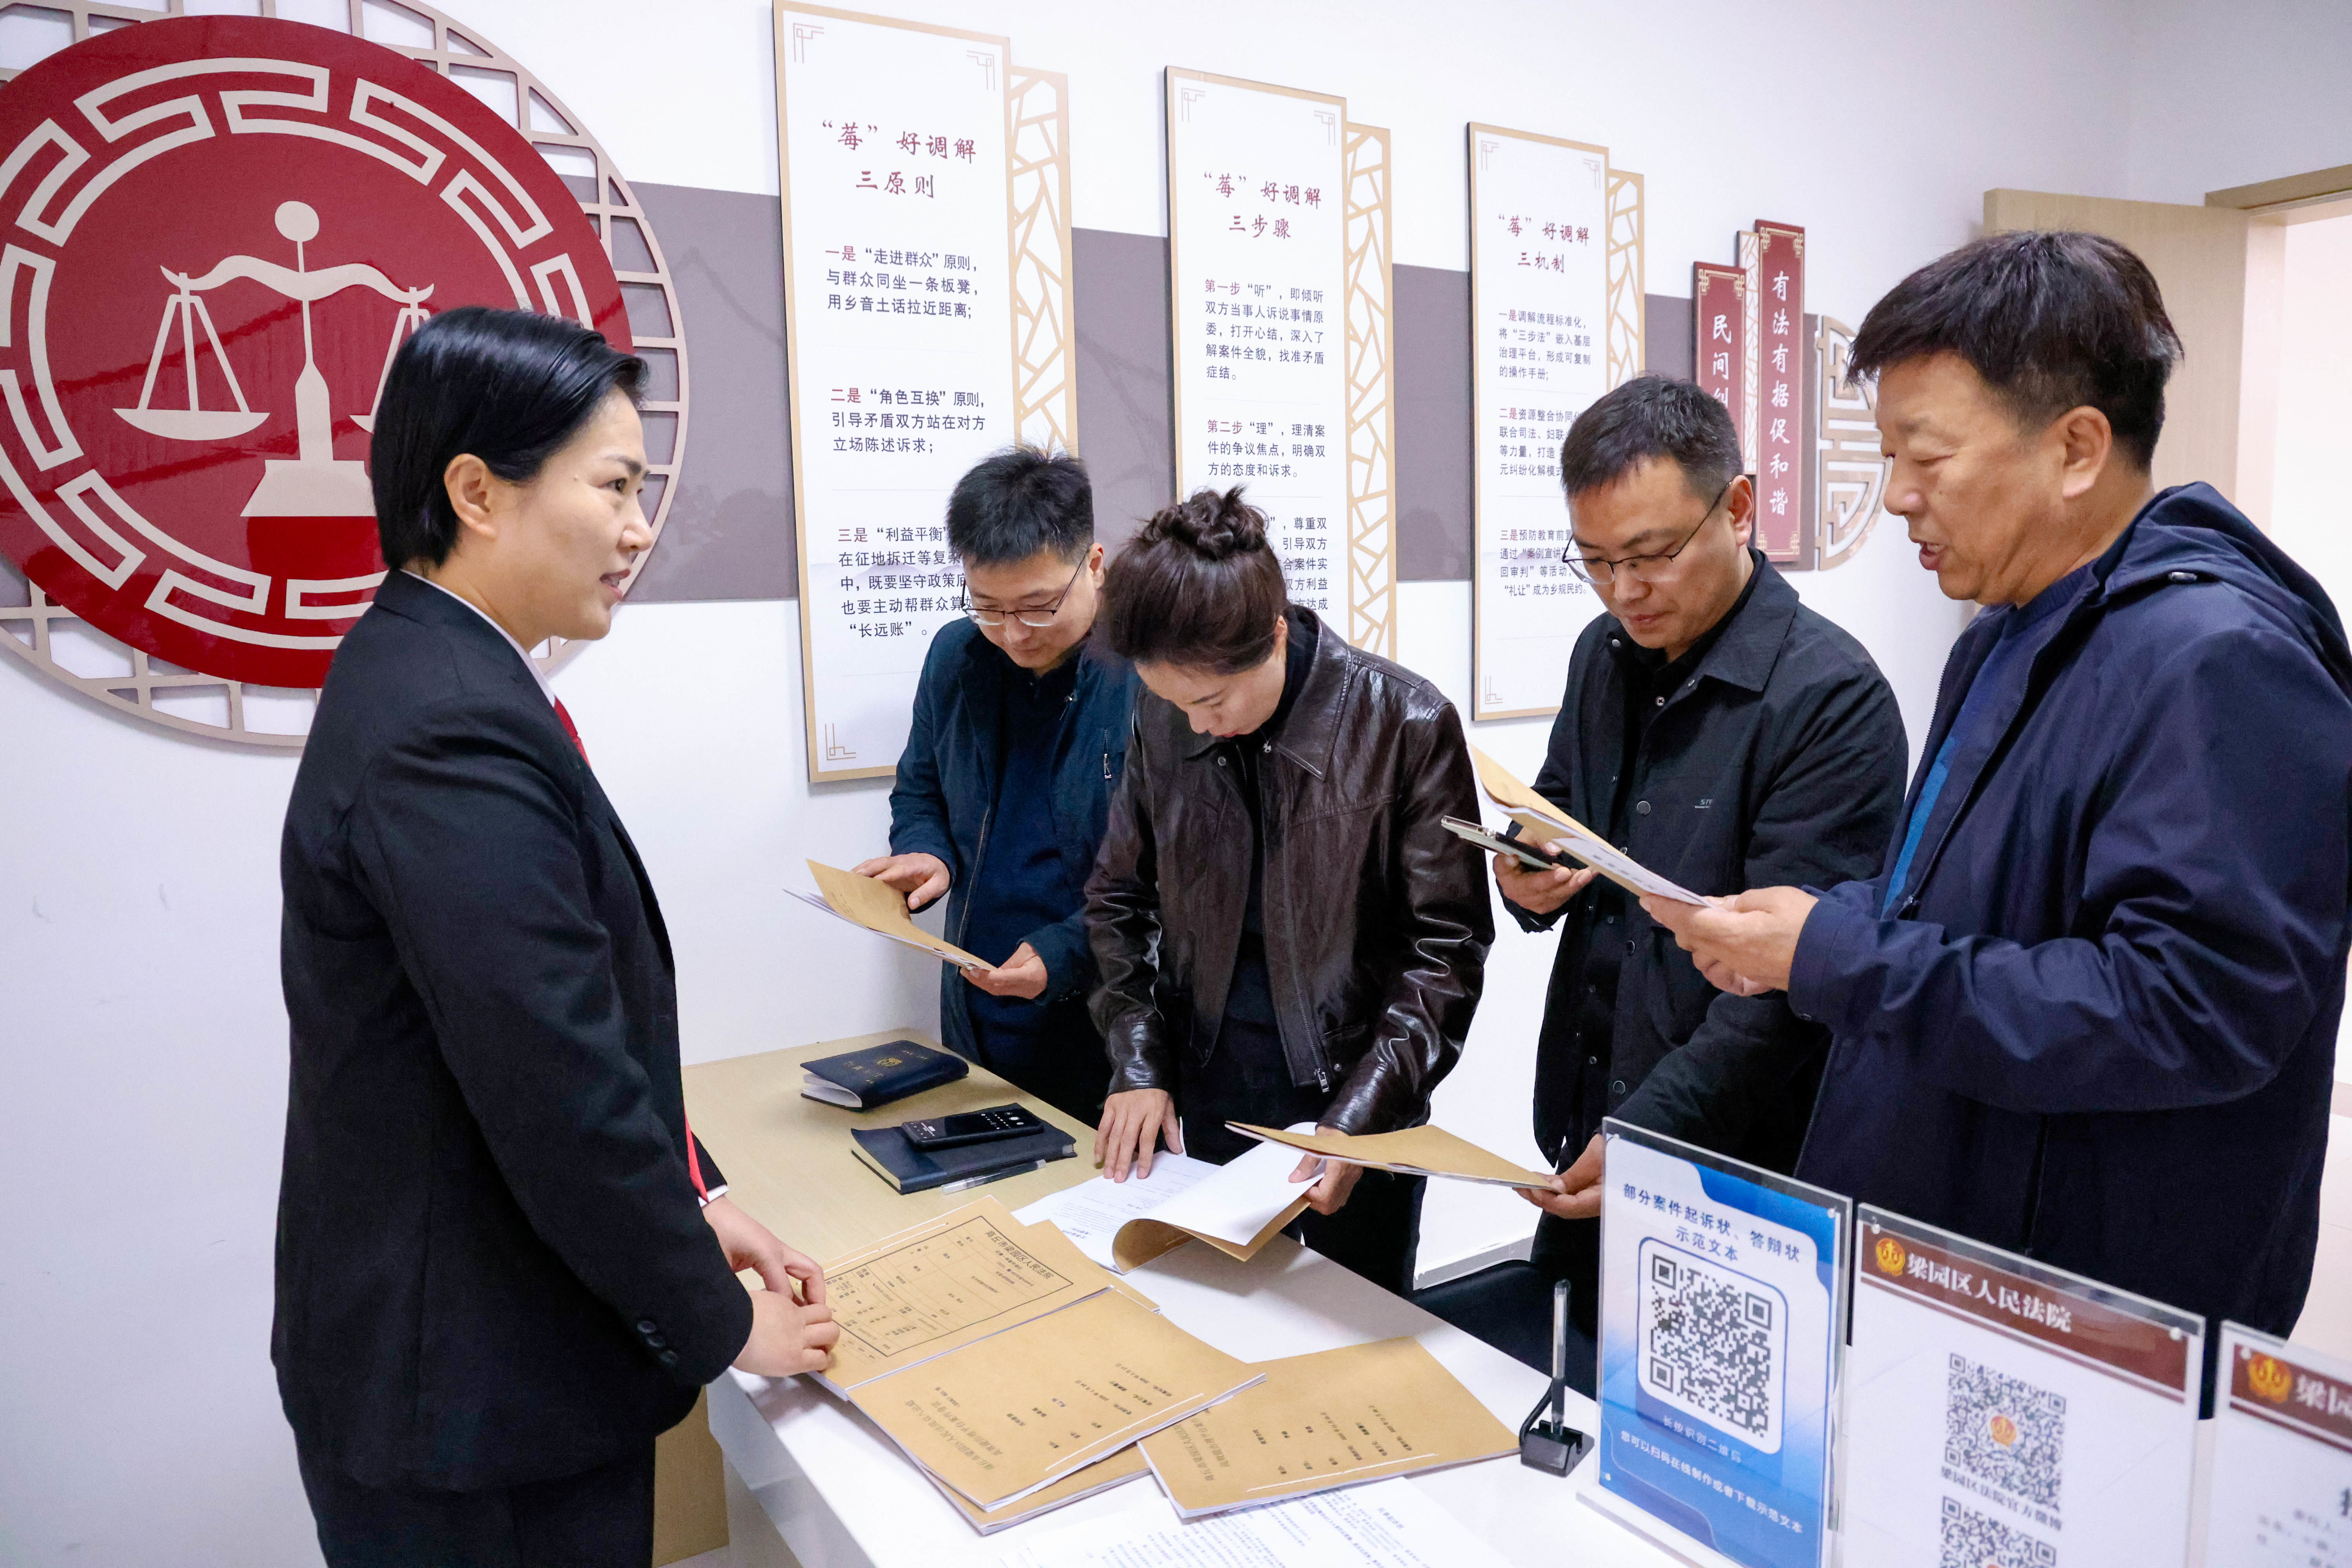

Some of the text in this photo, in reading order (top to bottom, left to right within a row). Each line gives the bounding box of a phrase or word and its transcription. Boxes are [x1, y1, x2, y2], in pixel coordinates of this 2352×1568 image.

[856, 171, 935, 198] 三原则
[1229, 214, 1291, 240] 三步骤
[825, 246, 978, 272] 一是“走进群众”原则，
[1518, 251, 1565, 273] 三机制
[826, 269, 978, 295] 与群众同坐一条板凳，
[1205, 279, 1323, 303] 第一步“听”，即倾听
[1205, 301, 1324, 323] 双方当事人诉说事情原
[1499, 309, 1586, 329] 一是调解流程标准化，
[1206, 322, 1324, 344] 委，打开心结，深入了
[1206, 343, 1325, 365] 解案件全貌，找准矛盾
[1499, 346, 1591, 365] 治理平台，形成可复制
[1207, 366, 1237, 380] 症结。
[831, 387, 985, 408] 二是“角色互换”原则，
[1769, 270, 1790, 516] 有法有据促和谐
[833, 412, 985, 431] 引导矛盾双方站在对方
[1207, 419, 1325, 437] 第二步“理”，理清案
[833, 437, 934, 454] 立场陈述诉求；
[1208, 441, 1325, 458] 件的争议焦点，明确双
[1208, 462, 1298, 478] 方的态度和诉求。
[1283, 537, 1327, 550] 引导双方
[1279, 557, 1327, 570] 合案件实
[1288, 597, 1328, 610] 方达成
[1623, 1183, 1800, 1263] 部分案件起诉状、答辩状
[985, 1230, 1054, 1279] 商丘市梁园区人民法院
[1676, 1226, 1738, 1261] 示范文本
[1908, 1253, 2072, 1333] 梁园区人民法院
